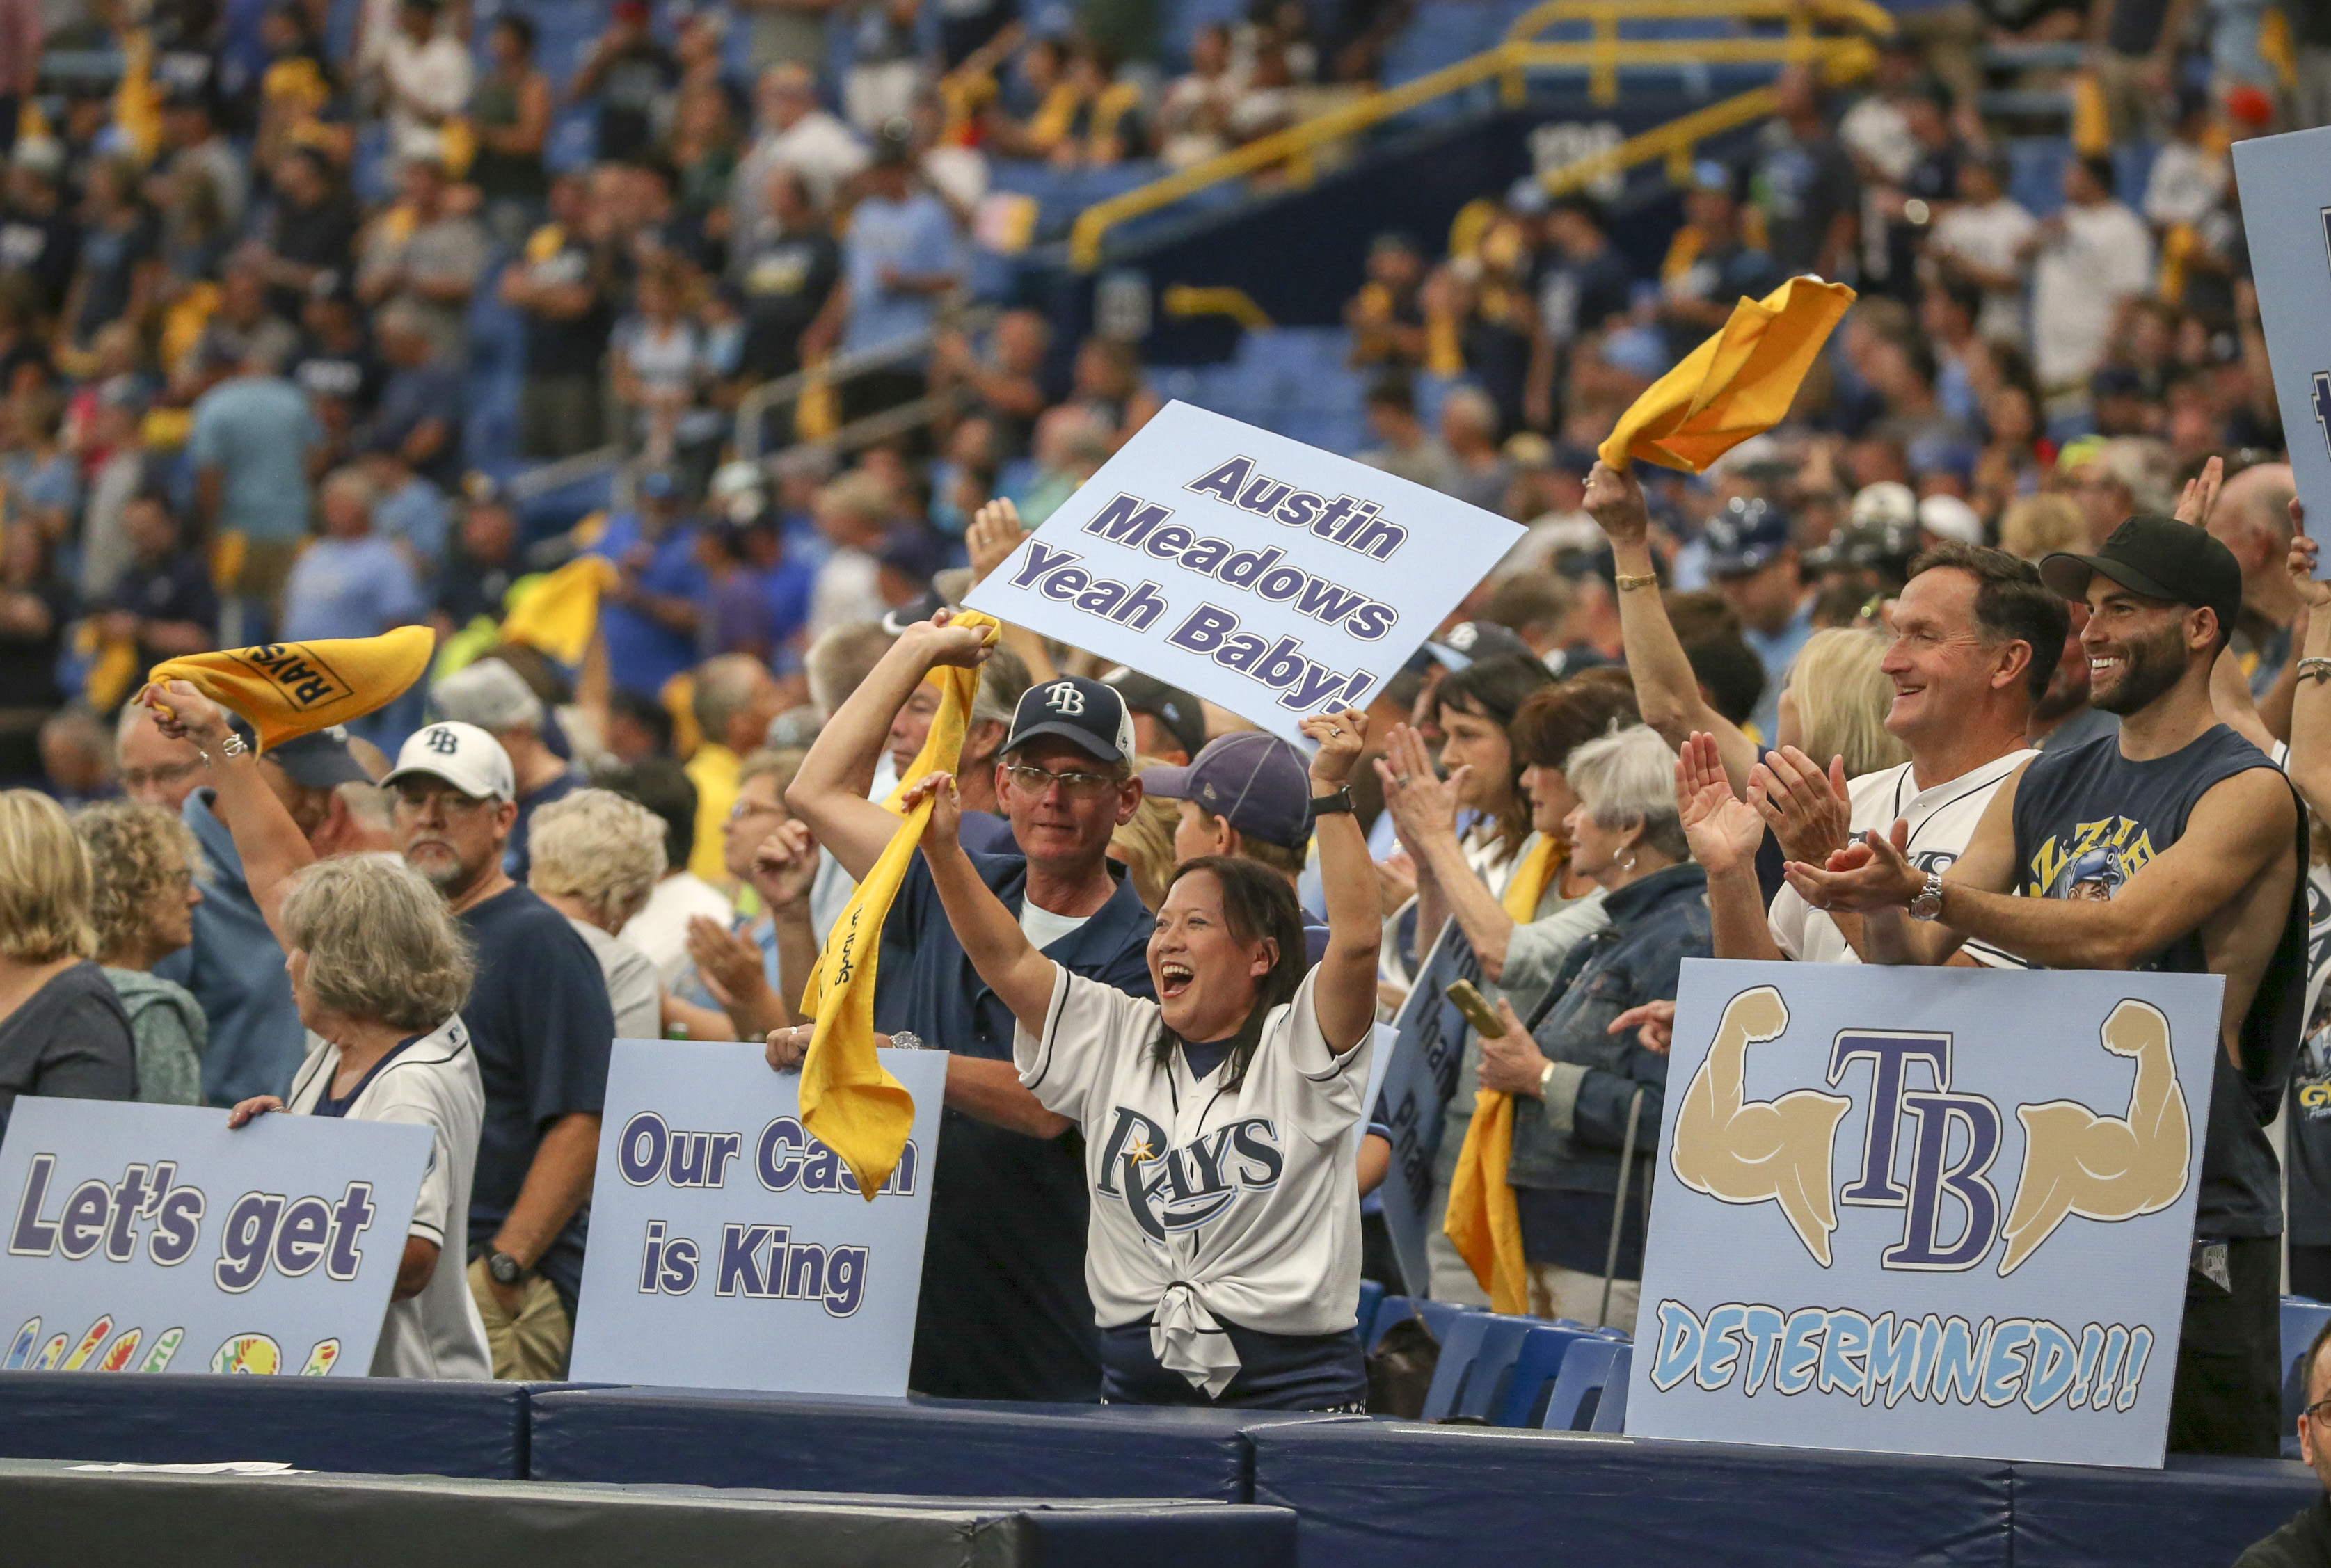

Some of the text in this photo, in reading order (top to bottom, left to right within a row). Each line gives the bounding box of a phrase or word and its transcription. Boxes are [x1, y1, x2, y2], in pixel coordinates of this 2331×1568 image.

[1184, 454, 1409, 563] Austin
[1081, 490, 1399, 642] Meadows
[251, 644, 333, 705] RAYS
[1008, 538, 1378, 714] Yeah Baby!
[426, 726, 459, 755] TB
[1044, 681, 1085, 717] TB
[617, 1111, 742, 1188] Our
[1825, 1028, 2003, 1273] TB
[8, 1152, 376, 1293] Let's get
[638, 1219, 870, 1318] is King
[1649, 1299, 2155, 1414] DETERMINED!!!
